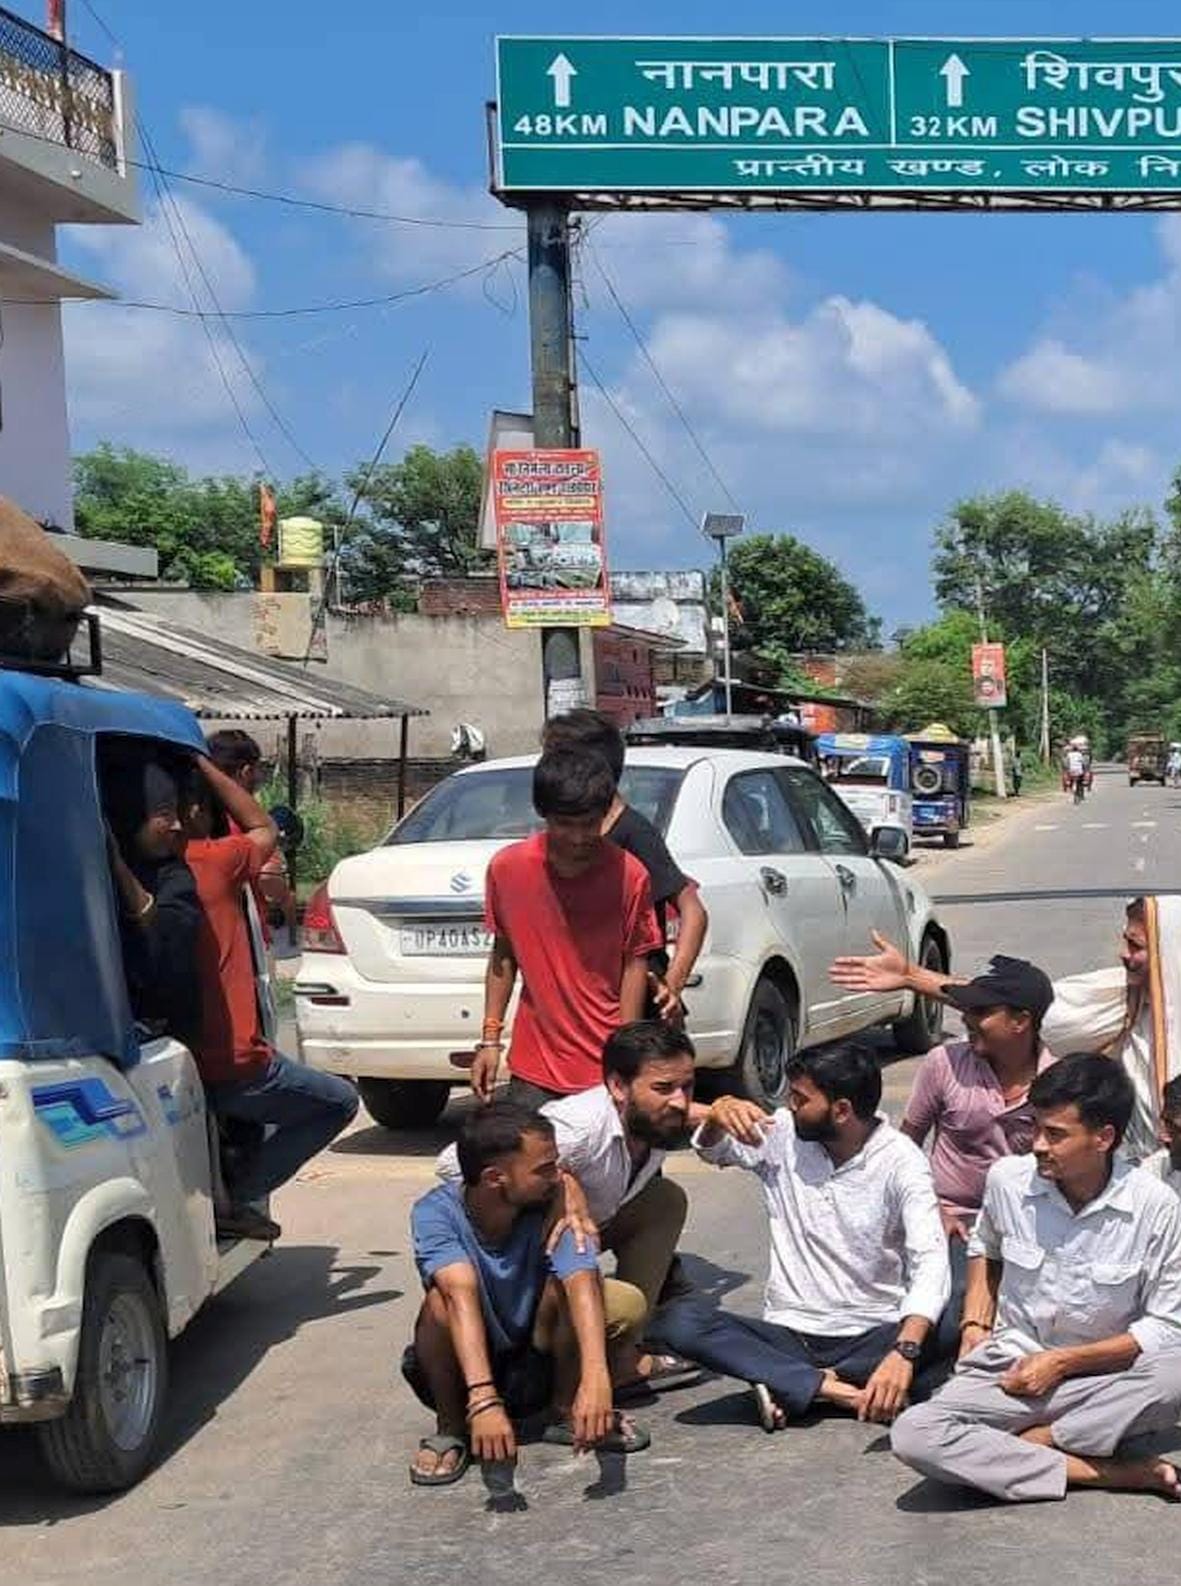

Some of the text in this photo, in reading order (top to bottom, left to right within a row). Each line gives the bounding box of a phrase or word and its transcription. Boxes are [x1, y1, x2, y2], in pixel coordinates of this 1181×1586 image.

[635, 61, 835, 90] नानपारा
[624, 106, 870, 137] NANPARA
[734, 153, 866, 177] प्रान्तीय
[1023, 154, 1110, 178] लोक
